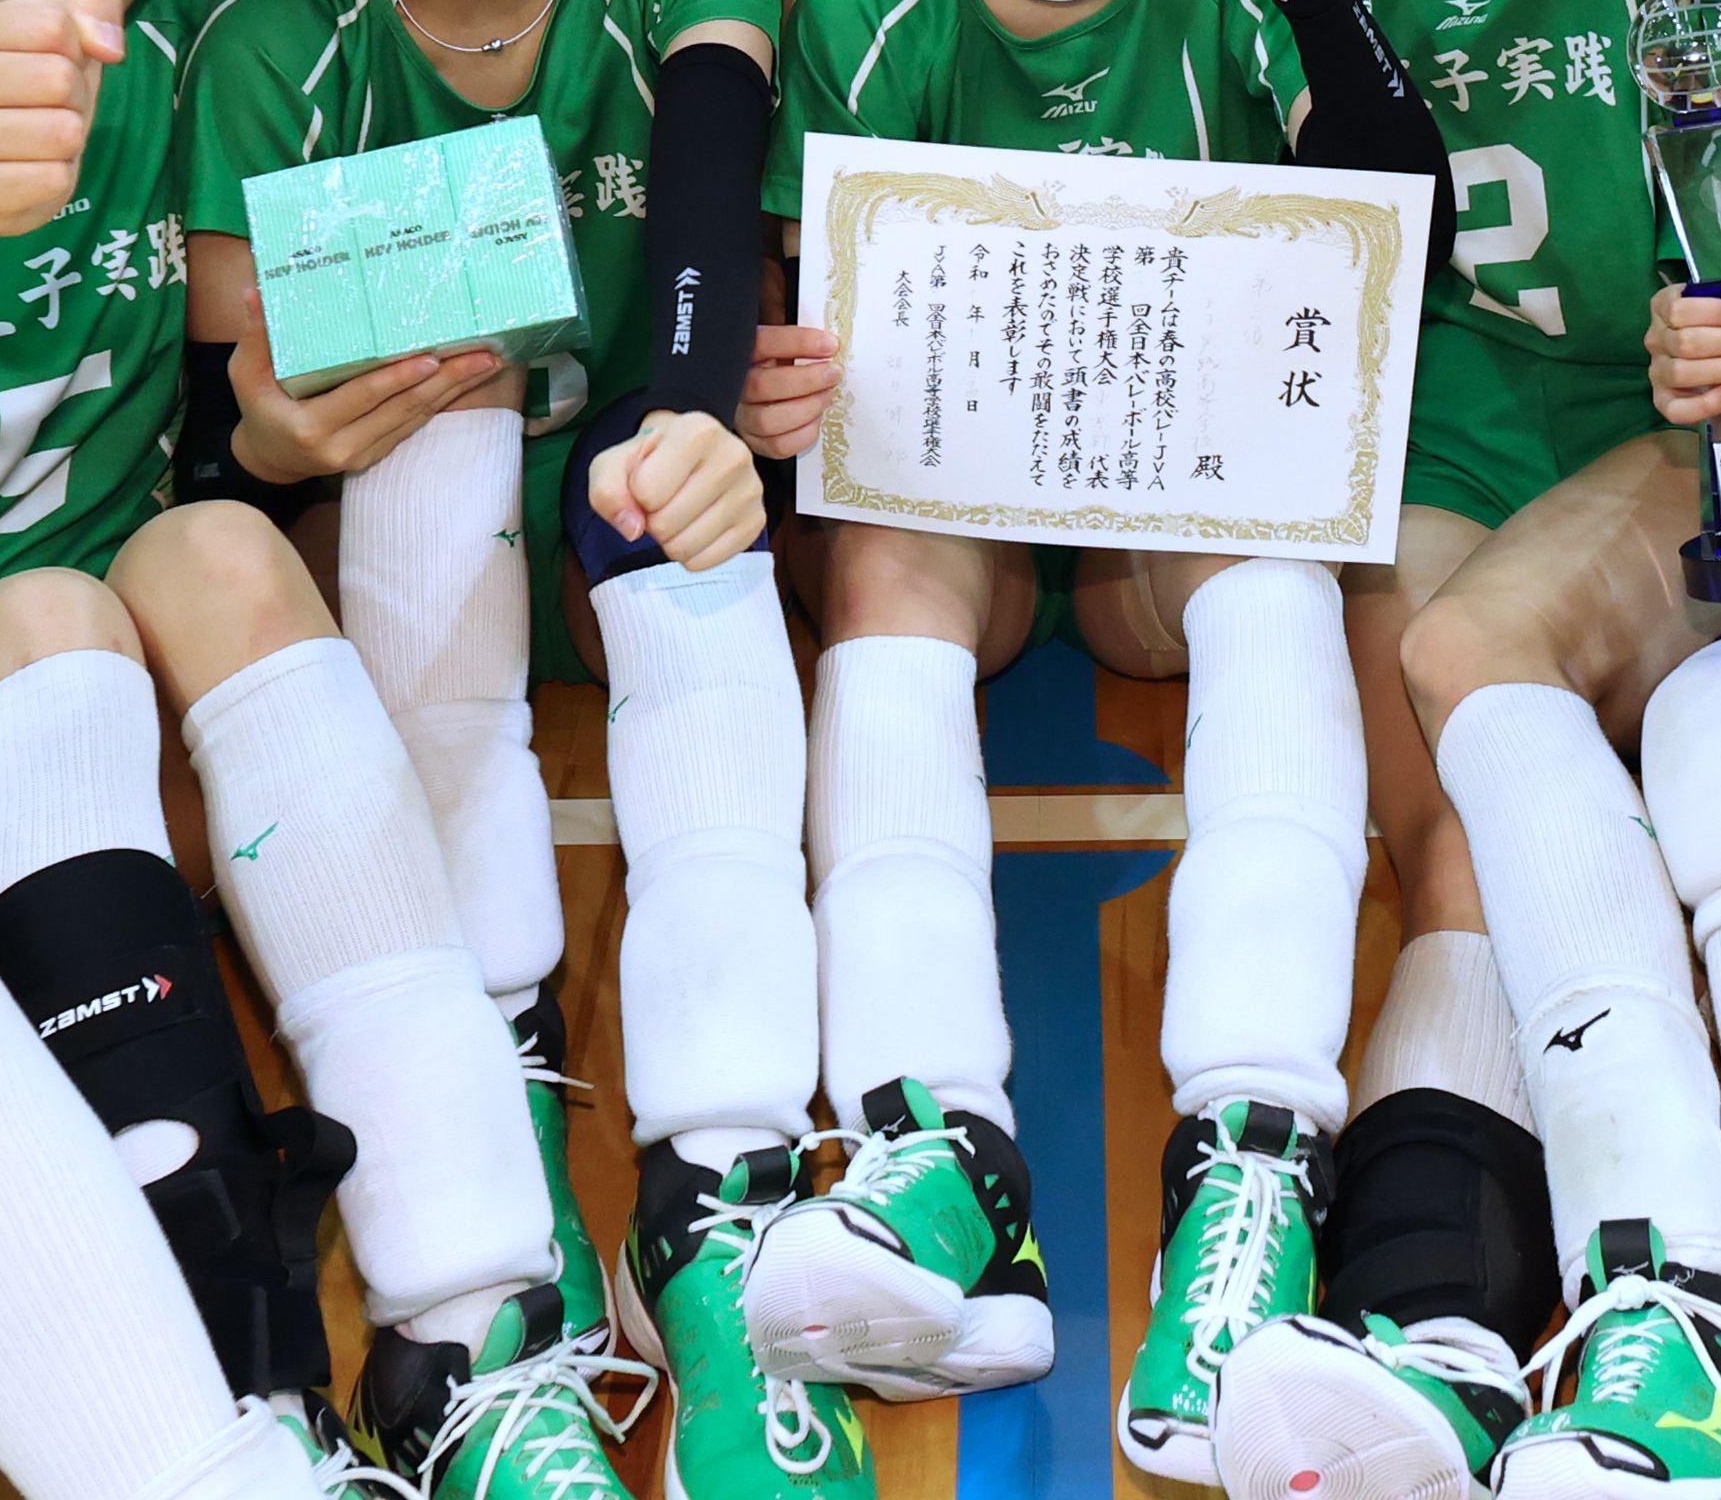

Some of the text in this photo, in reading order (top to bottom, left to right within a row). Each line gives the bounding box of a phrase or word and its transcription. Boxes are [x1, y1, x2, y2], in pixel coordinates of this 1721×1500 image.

[1435, 14, 1487, 31] MIZUNO
[1401, 31, 1617, 112] 子実践
[1134, 245, 1156, 266] 第
[1449, 143, 1567, 336] 2
[968, 243, 990, 281] 令和
[892, 270, 914, 327] 大会会長
[967, 304, 985, 324] 年
[999, 240, 1029, 396] これを表彰します
[968, 351, 980, 368] 月
[1279, 307, 1331, 408] 賞状
[966, 400, 979, 412] 日
[1190, 454, 1225, 481] 殿
[38, 984, 141, 1039] ZAMST
